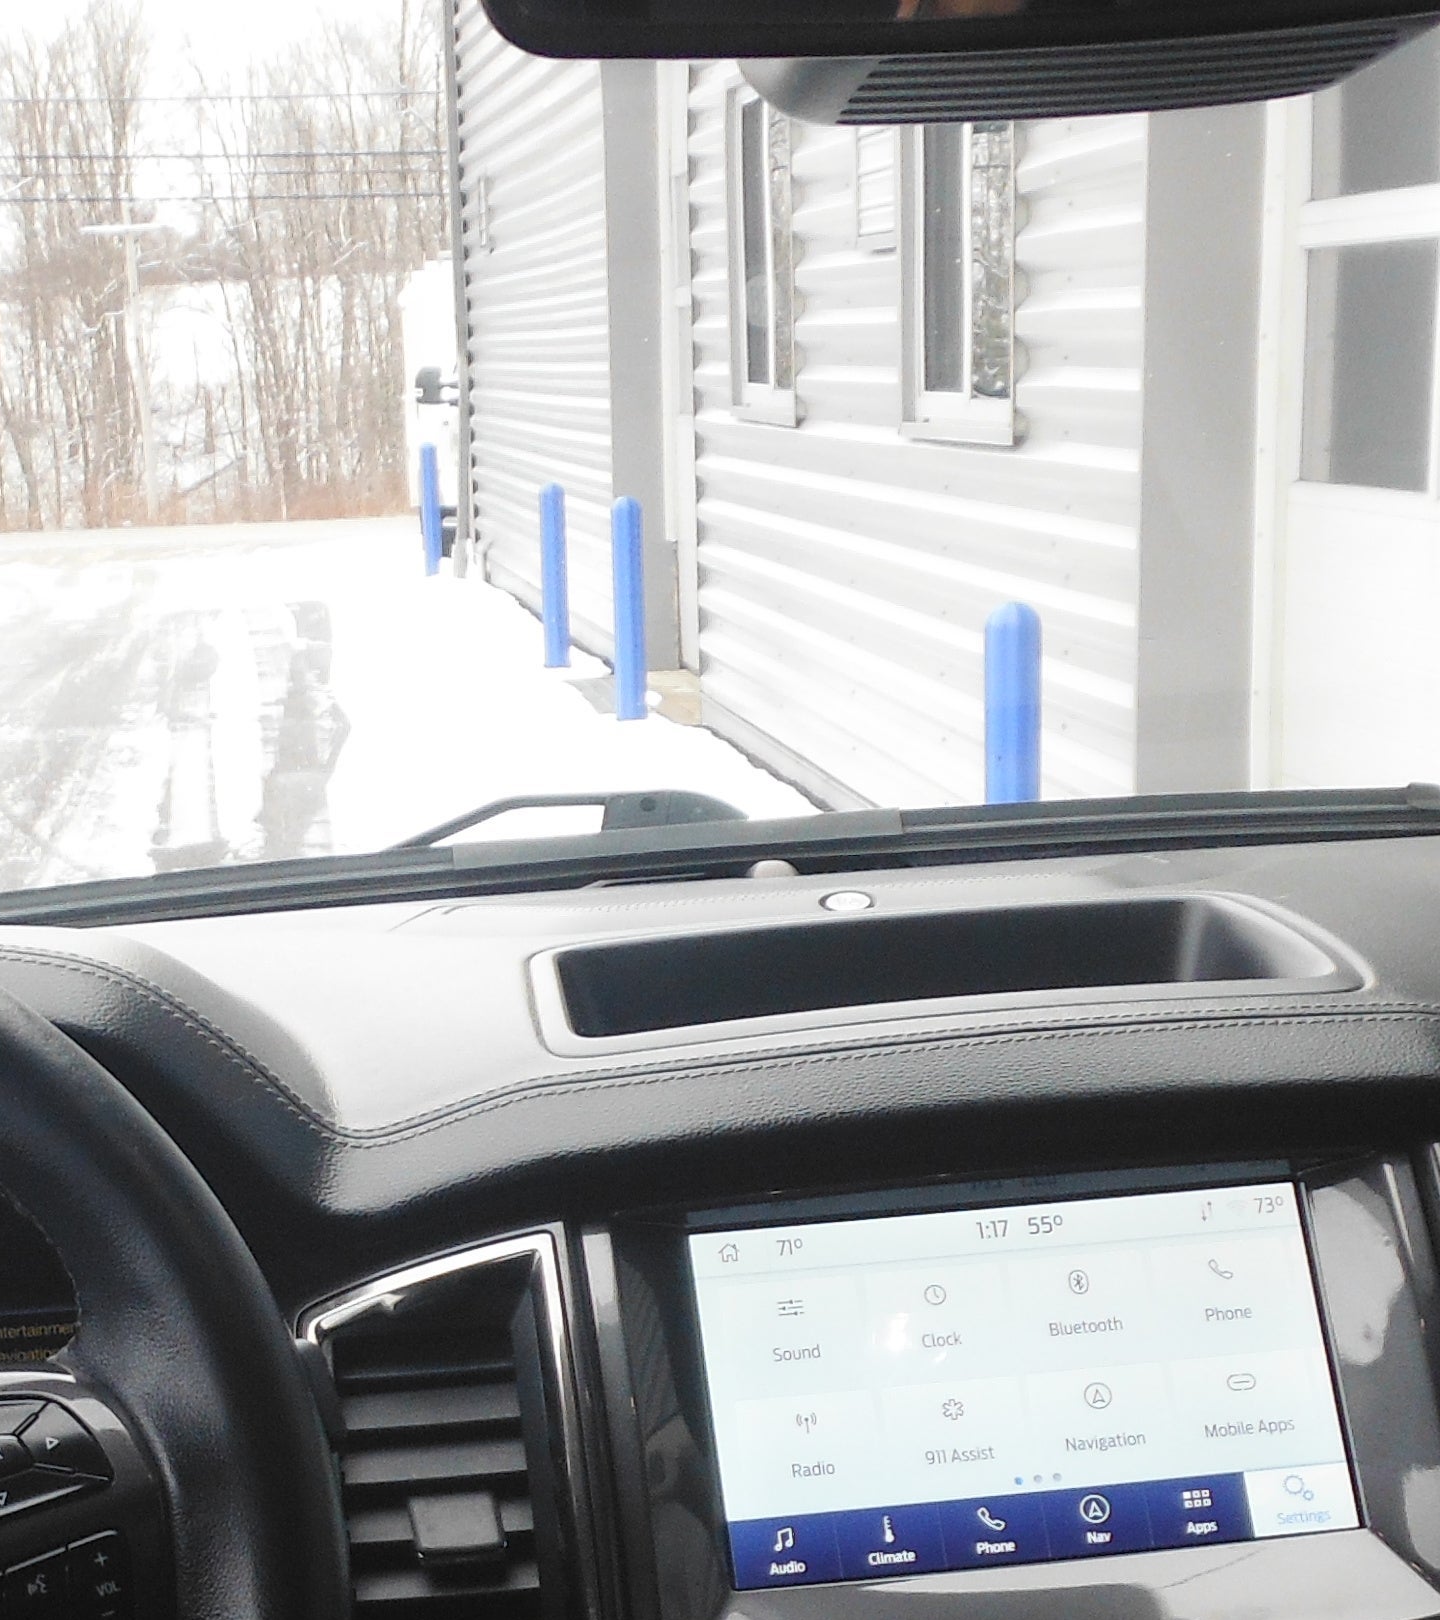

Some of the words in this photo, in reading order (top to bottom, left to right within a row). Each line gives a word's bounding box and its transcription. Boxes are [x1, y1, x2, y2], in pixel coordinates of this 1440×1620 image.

[976, 1220, 1008, 1239] 1:17
[1205, 1305, 1253, 1322] Phone
[1049, 1317, 1123, 1337] Bluetooth
[922, 1331, 963, 1348] Clock
[773, 1344, 821, 1362] Sound
[1205, 1420, 1254, 1438] Mobile
[1258, 1418, 1295, 1436] Apps
[1066, 1431, 1146, 1452] Navigation
[925, 1449, 947, 1465] 911
[951, 1446, 995, 1462] Assist
[792, 1461, 835, 1478] Radio
[1277, 1508, 1332, 1526] Settings
[1186, 1520, 1218, 1535] Apps
[1086, 1531, 1112, 1544] Nav
[976, 1541, 1016, 1554] Phone
[868, 1549, 916, 1566] Climate
[770, 1559, 806, 1576] Audio
[97, 1581, 121, 1596] VOL
